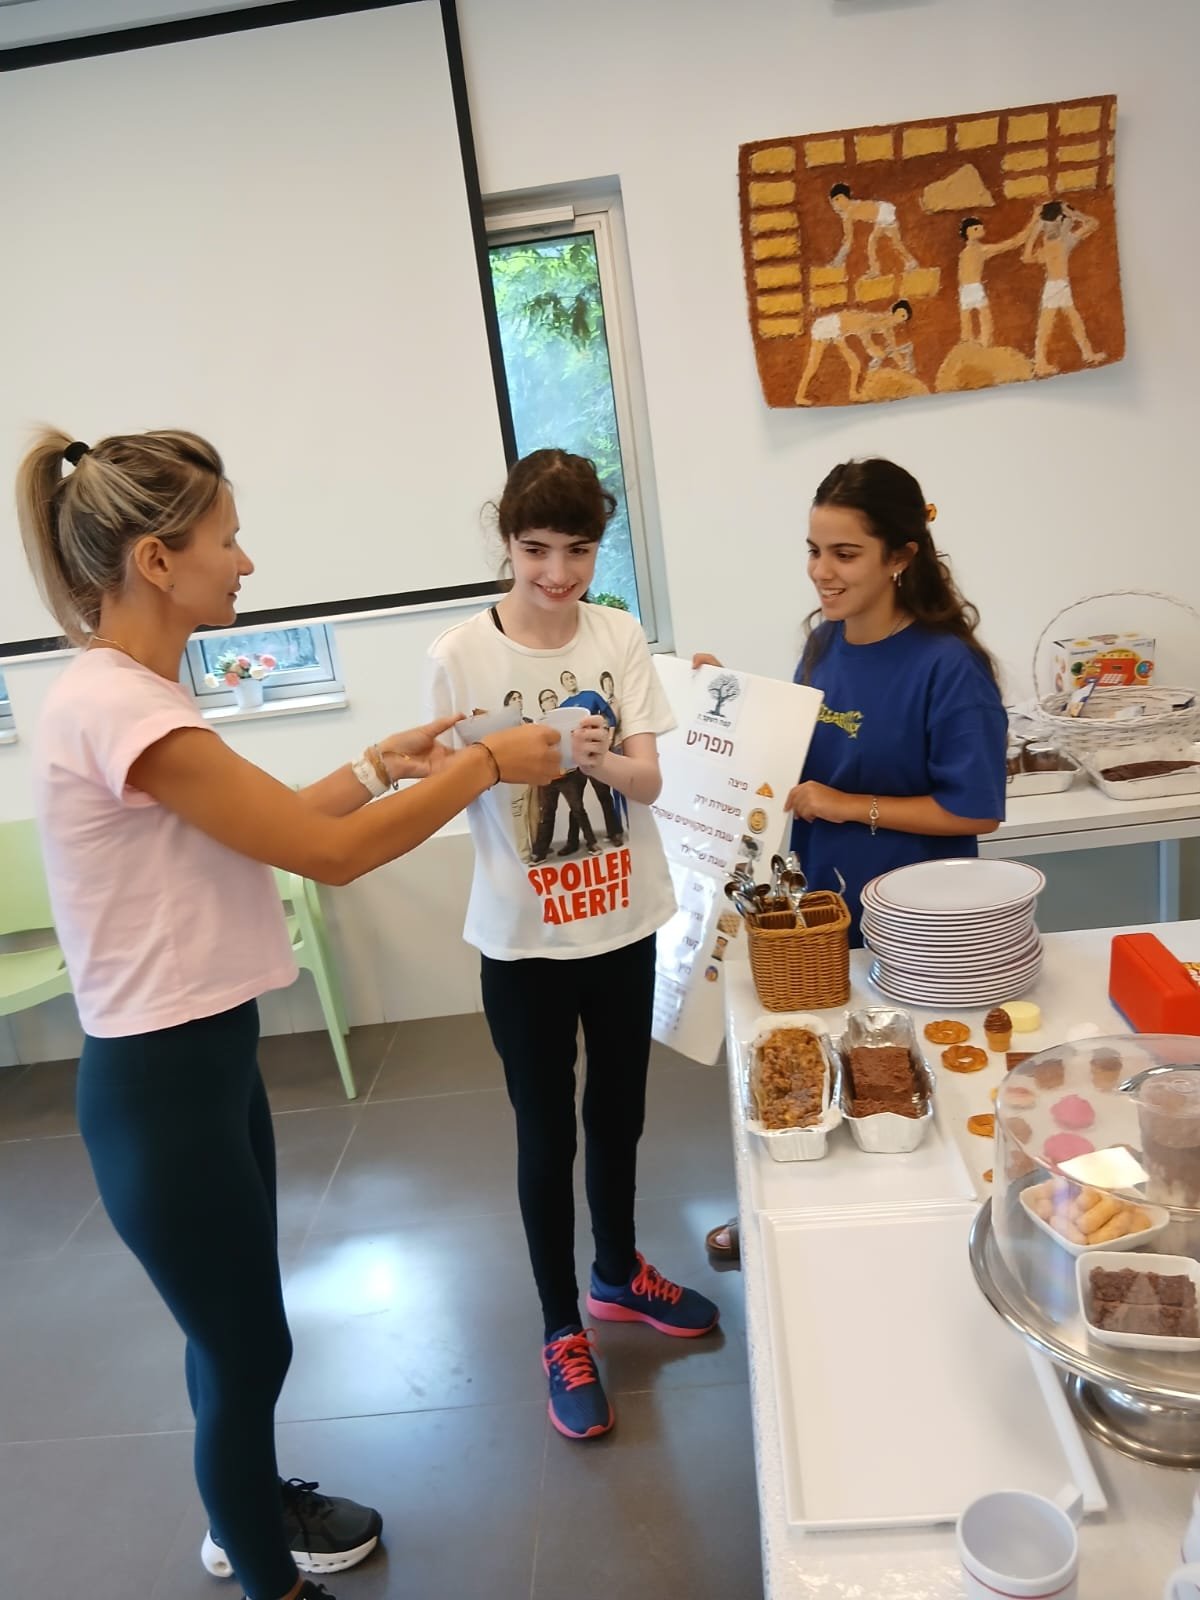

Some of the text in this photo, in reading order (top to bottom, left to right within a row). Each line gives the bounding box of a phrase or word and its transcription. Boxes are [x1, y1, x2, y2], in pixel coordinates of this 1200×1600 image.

[686, 729, 734, 757] תפריט
[728, 777, 748, 791] פיצה
[708, 798, 742, 817] פשטידת
[528, 848, 632, 897] SPOILER
[543, 879, 630, 926] ALERT!
